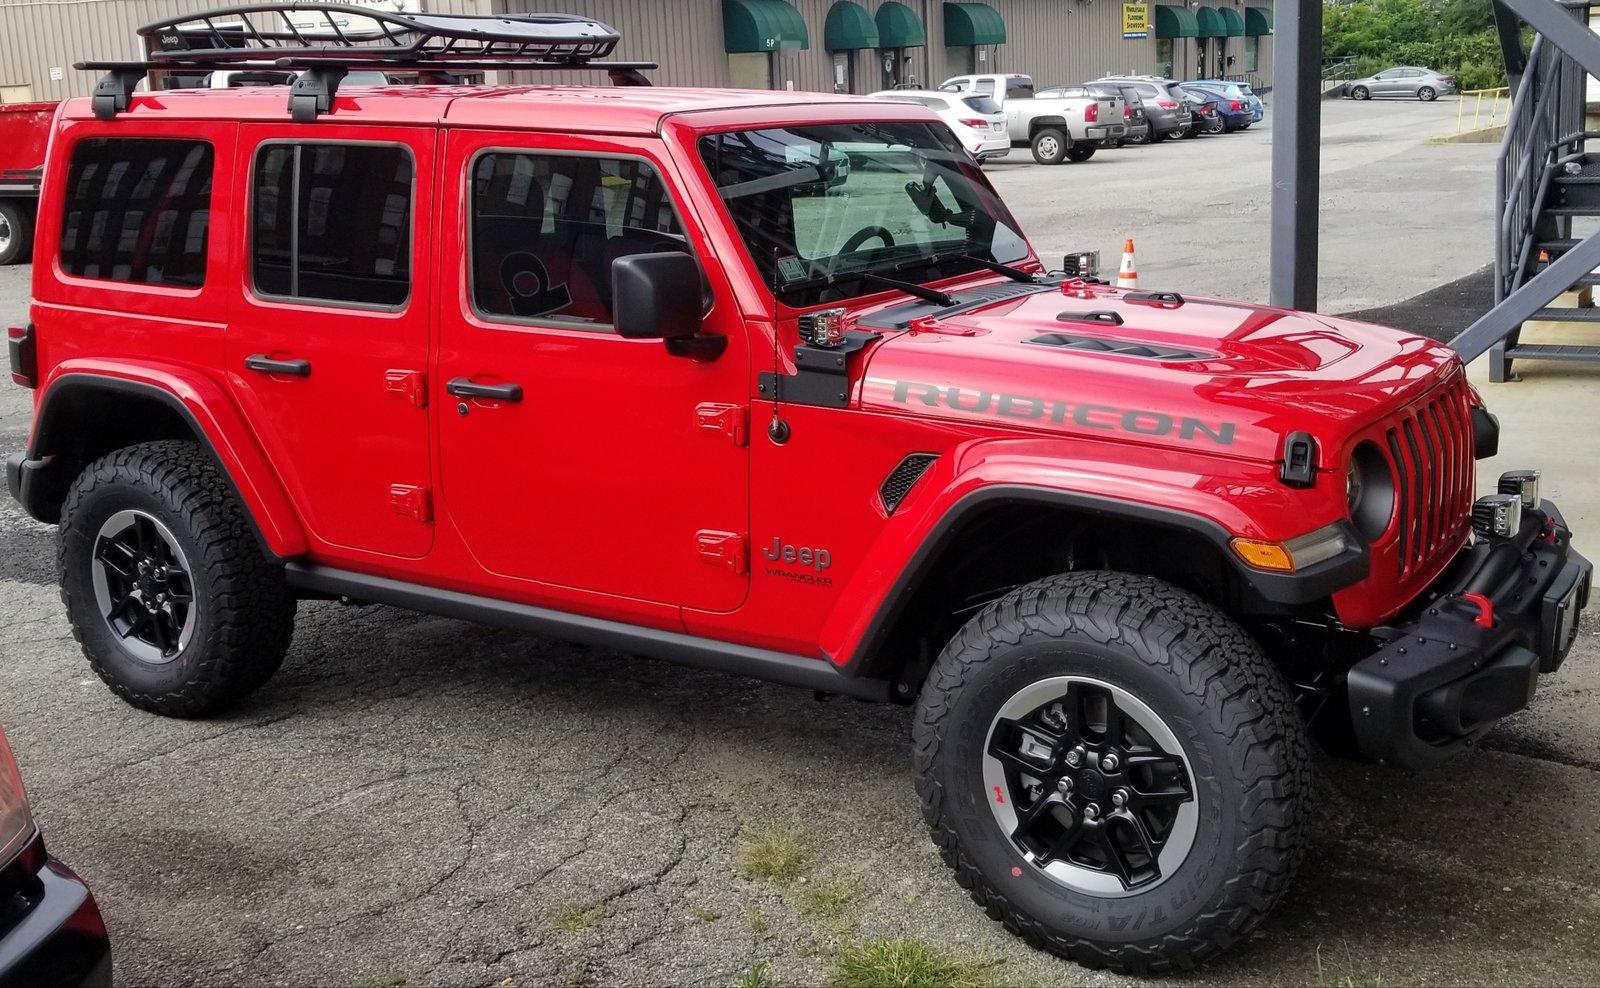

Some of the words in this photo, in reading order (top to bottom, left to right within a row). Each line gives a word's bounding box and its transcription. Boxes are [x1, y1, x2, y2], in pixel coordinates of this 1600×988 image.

[161, 34, 179, 45] Jeep
[893, 380, 1235, 445] RUBICON
[762, 536, 831, 572] Jeep
[765, 568, 833, 585] WRANGLER
